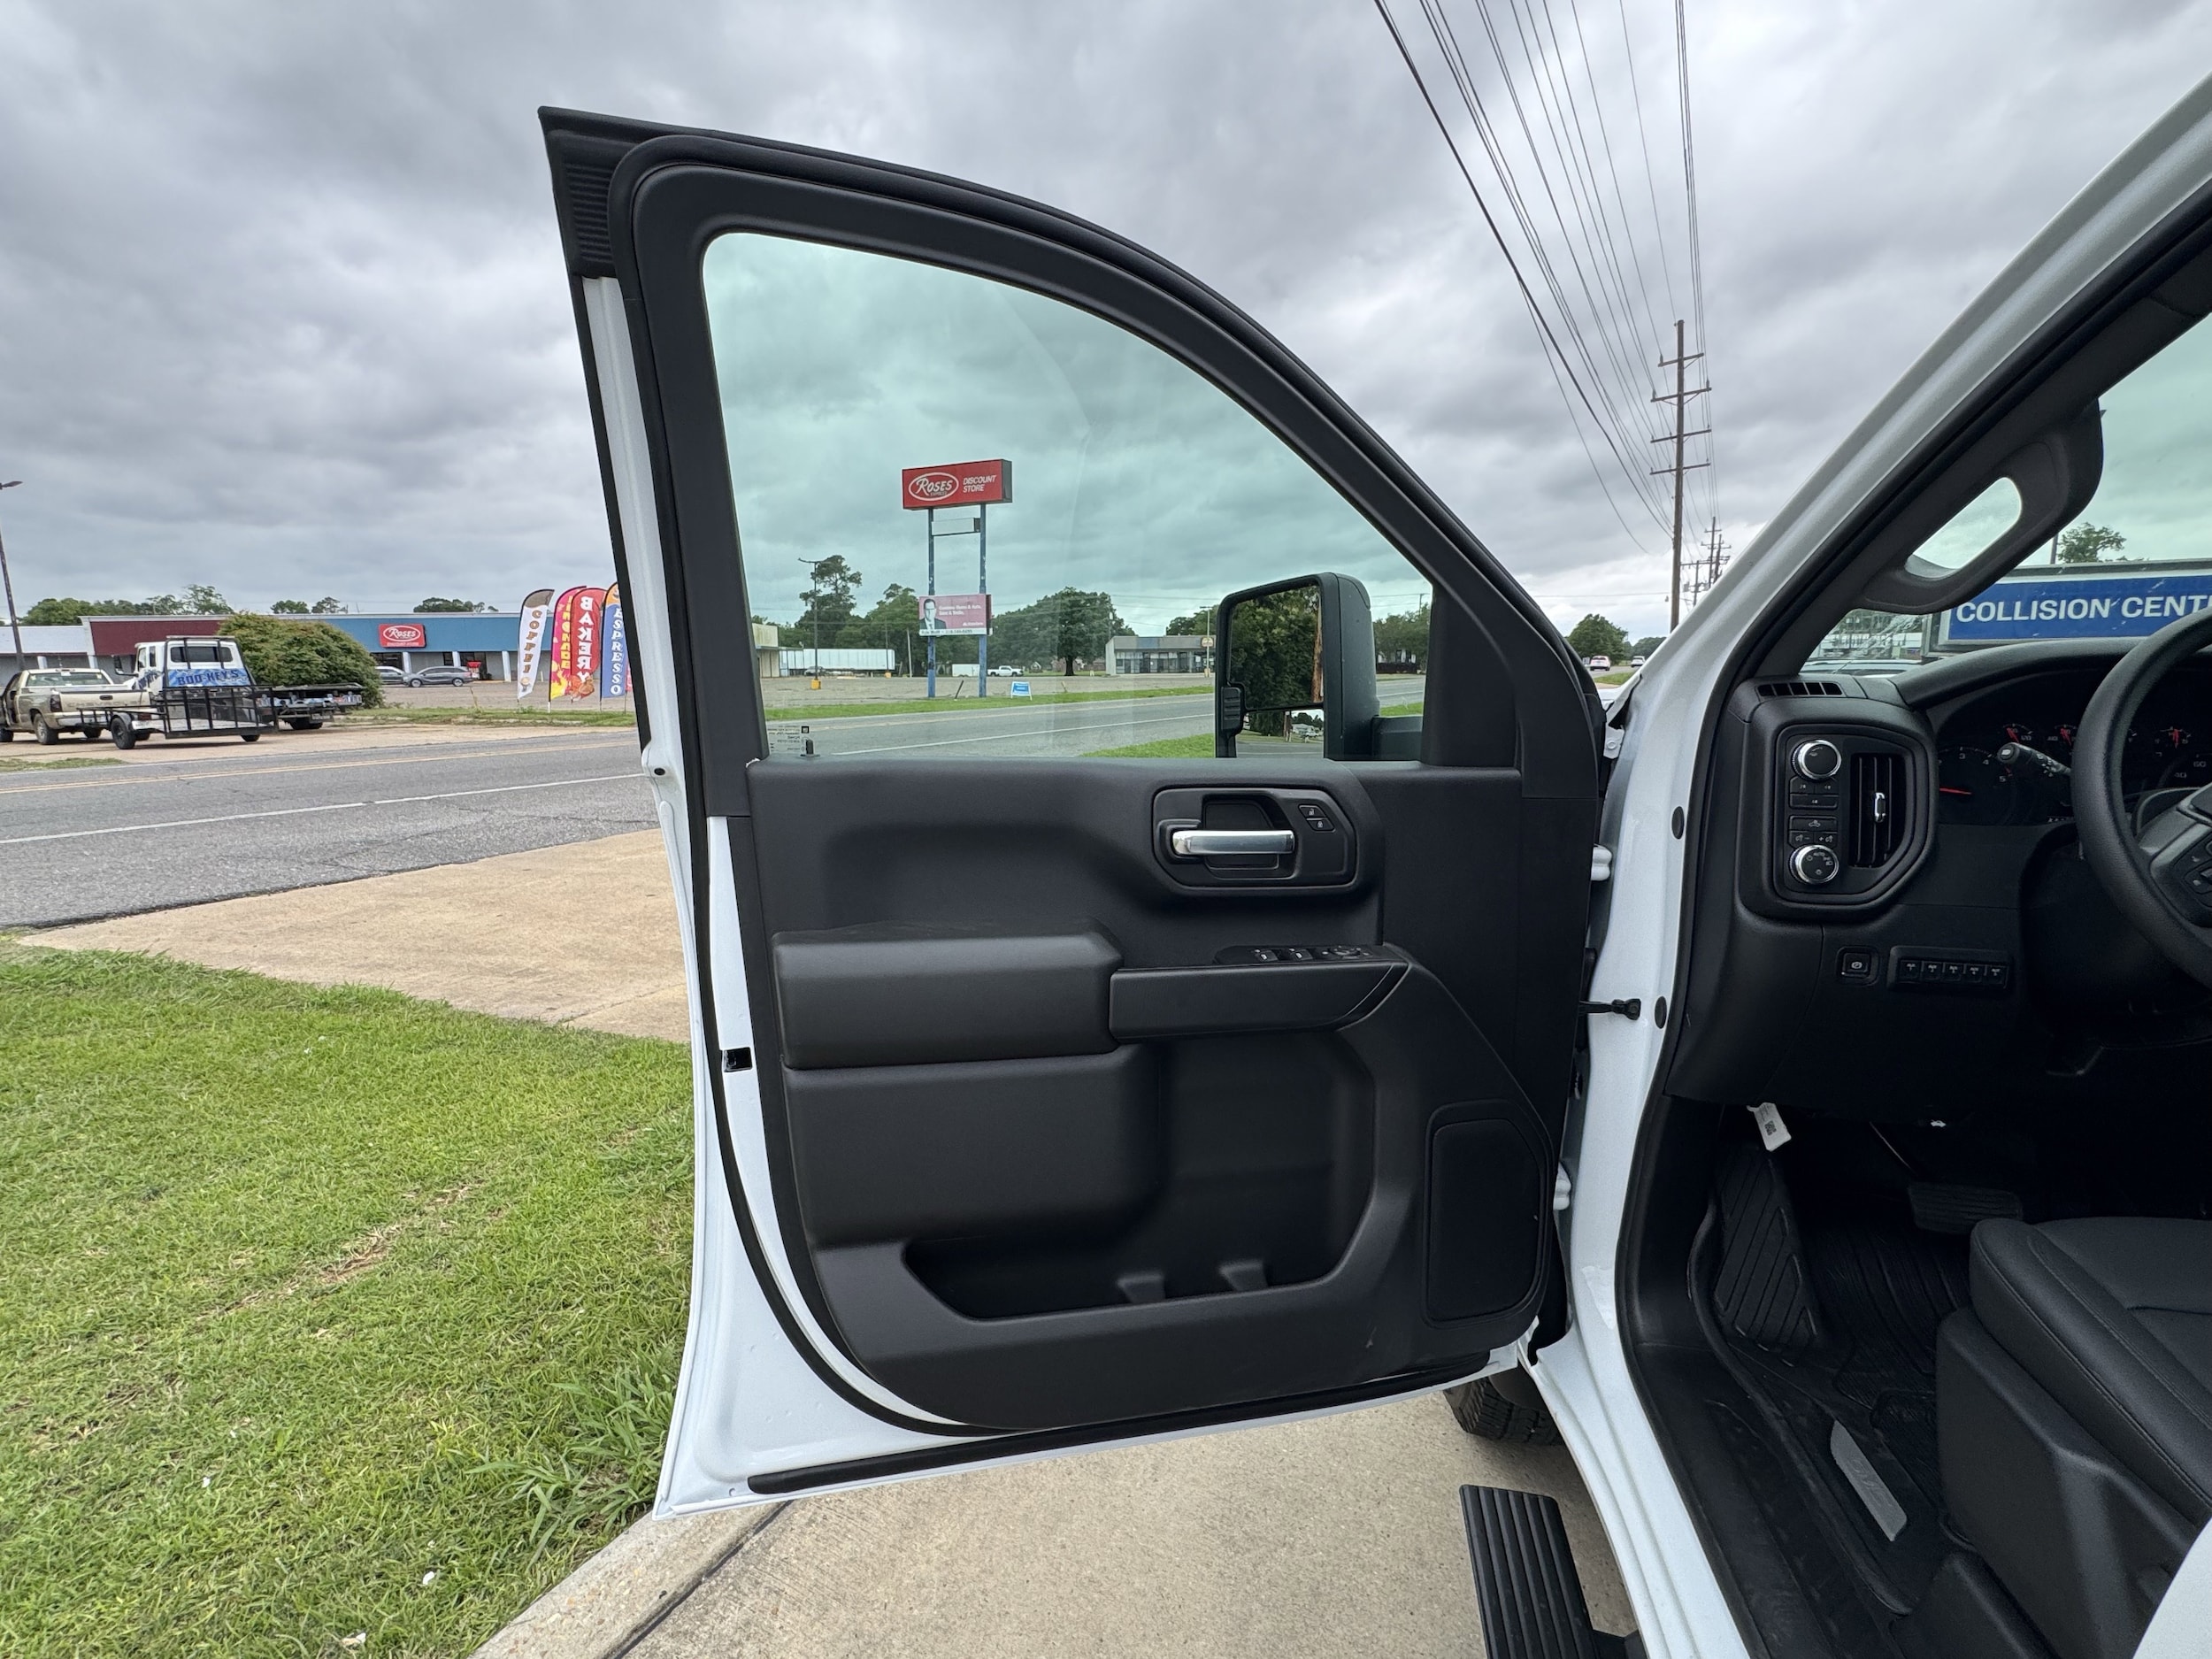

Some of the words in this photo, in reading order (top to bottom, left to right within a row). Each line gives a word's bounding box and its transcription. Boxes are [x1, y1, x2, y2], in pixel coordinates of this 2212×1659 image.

[916, 478, 953, 495] ROSES
[963, 475, 996, 485] DISCOUNT
[963, 484, 985, 493] STORE
[1956, 598, 2112, 622] COLLISION
[523, 610, 542, 673] COFFEE
[611, 608, 624, 695] ESPRESSO
